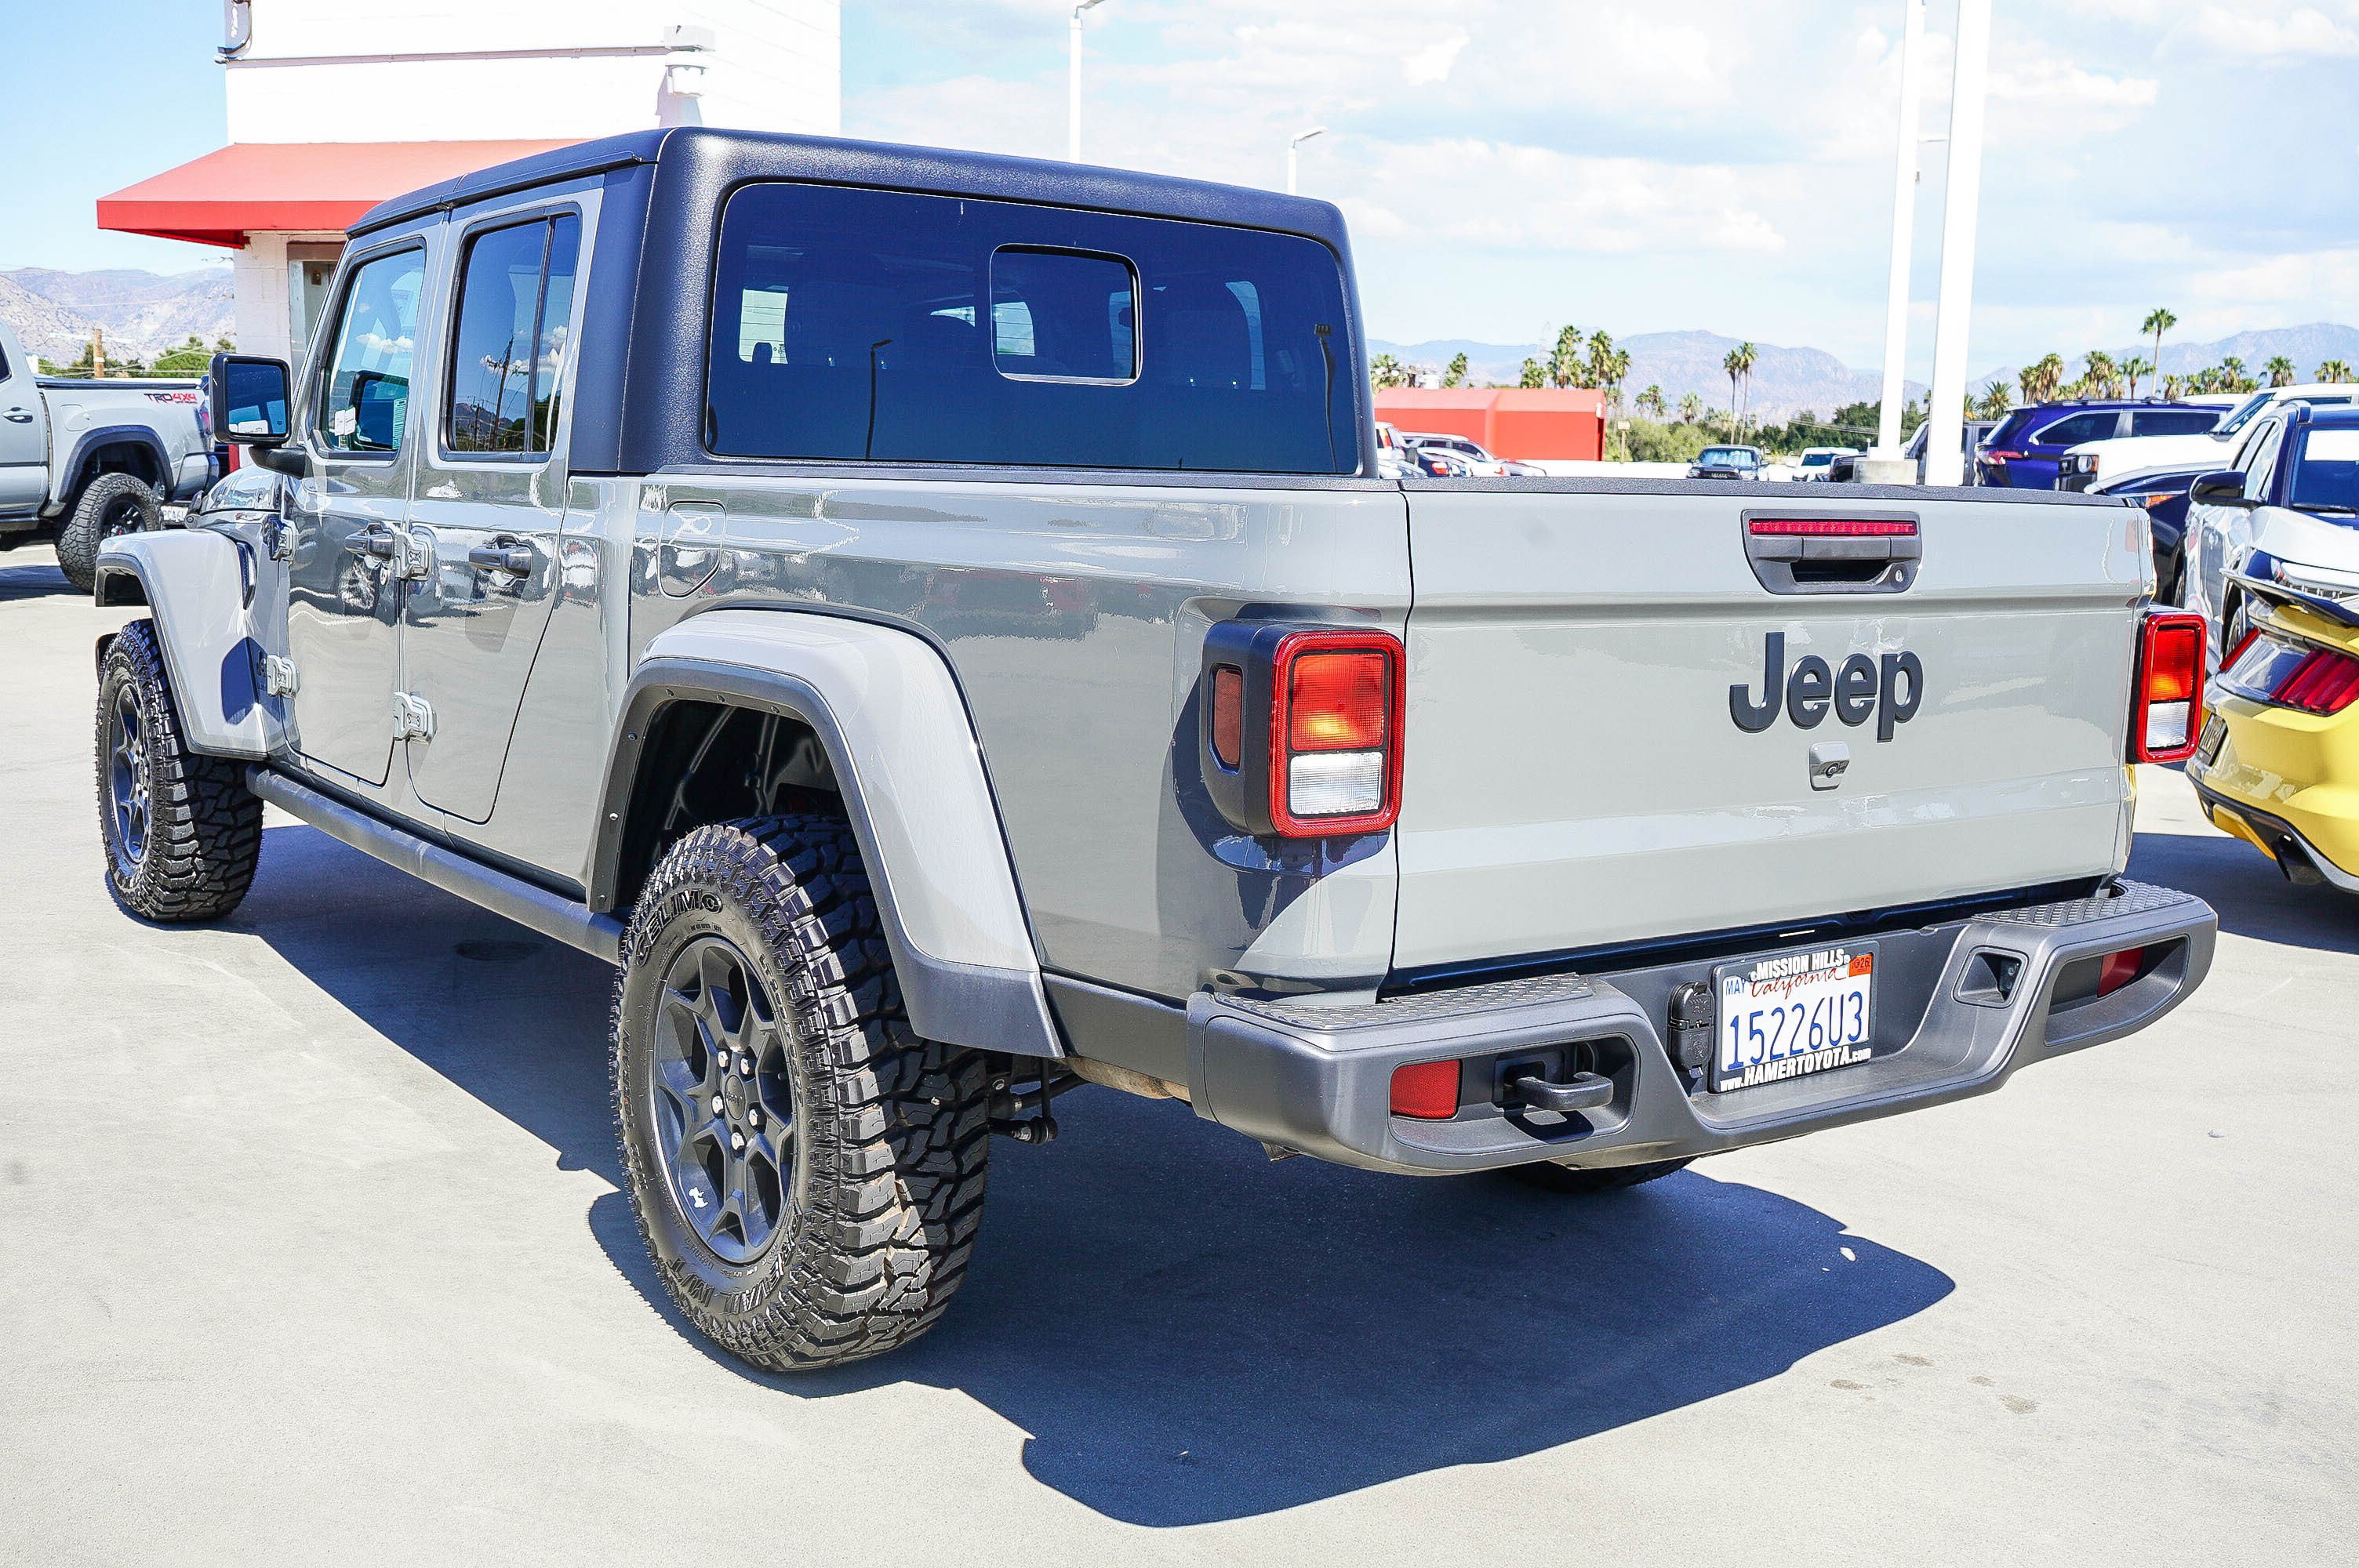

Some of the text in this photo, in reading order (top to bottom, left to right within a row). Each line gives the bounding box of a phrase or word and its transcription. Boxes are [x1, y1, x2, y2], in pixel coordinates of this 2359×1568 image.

[1729, 632, 1923, 743] Jeep
[635, 887, 723, 967] CELIMO
[1725, 978, 1747, 996] MAY
[1751, 967, 1847, 1000] California
[1756, 948, 1845, 982] MISSION HILLS
[1727, 990, 1863, 1070] 15226U3
[1719, 1045, 1872, 1092] www.HAMERTOYOTA.com
